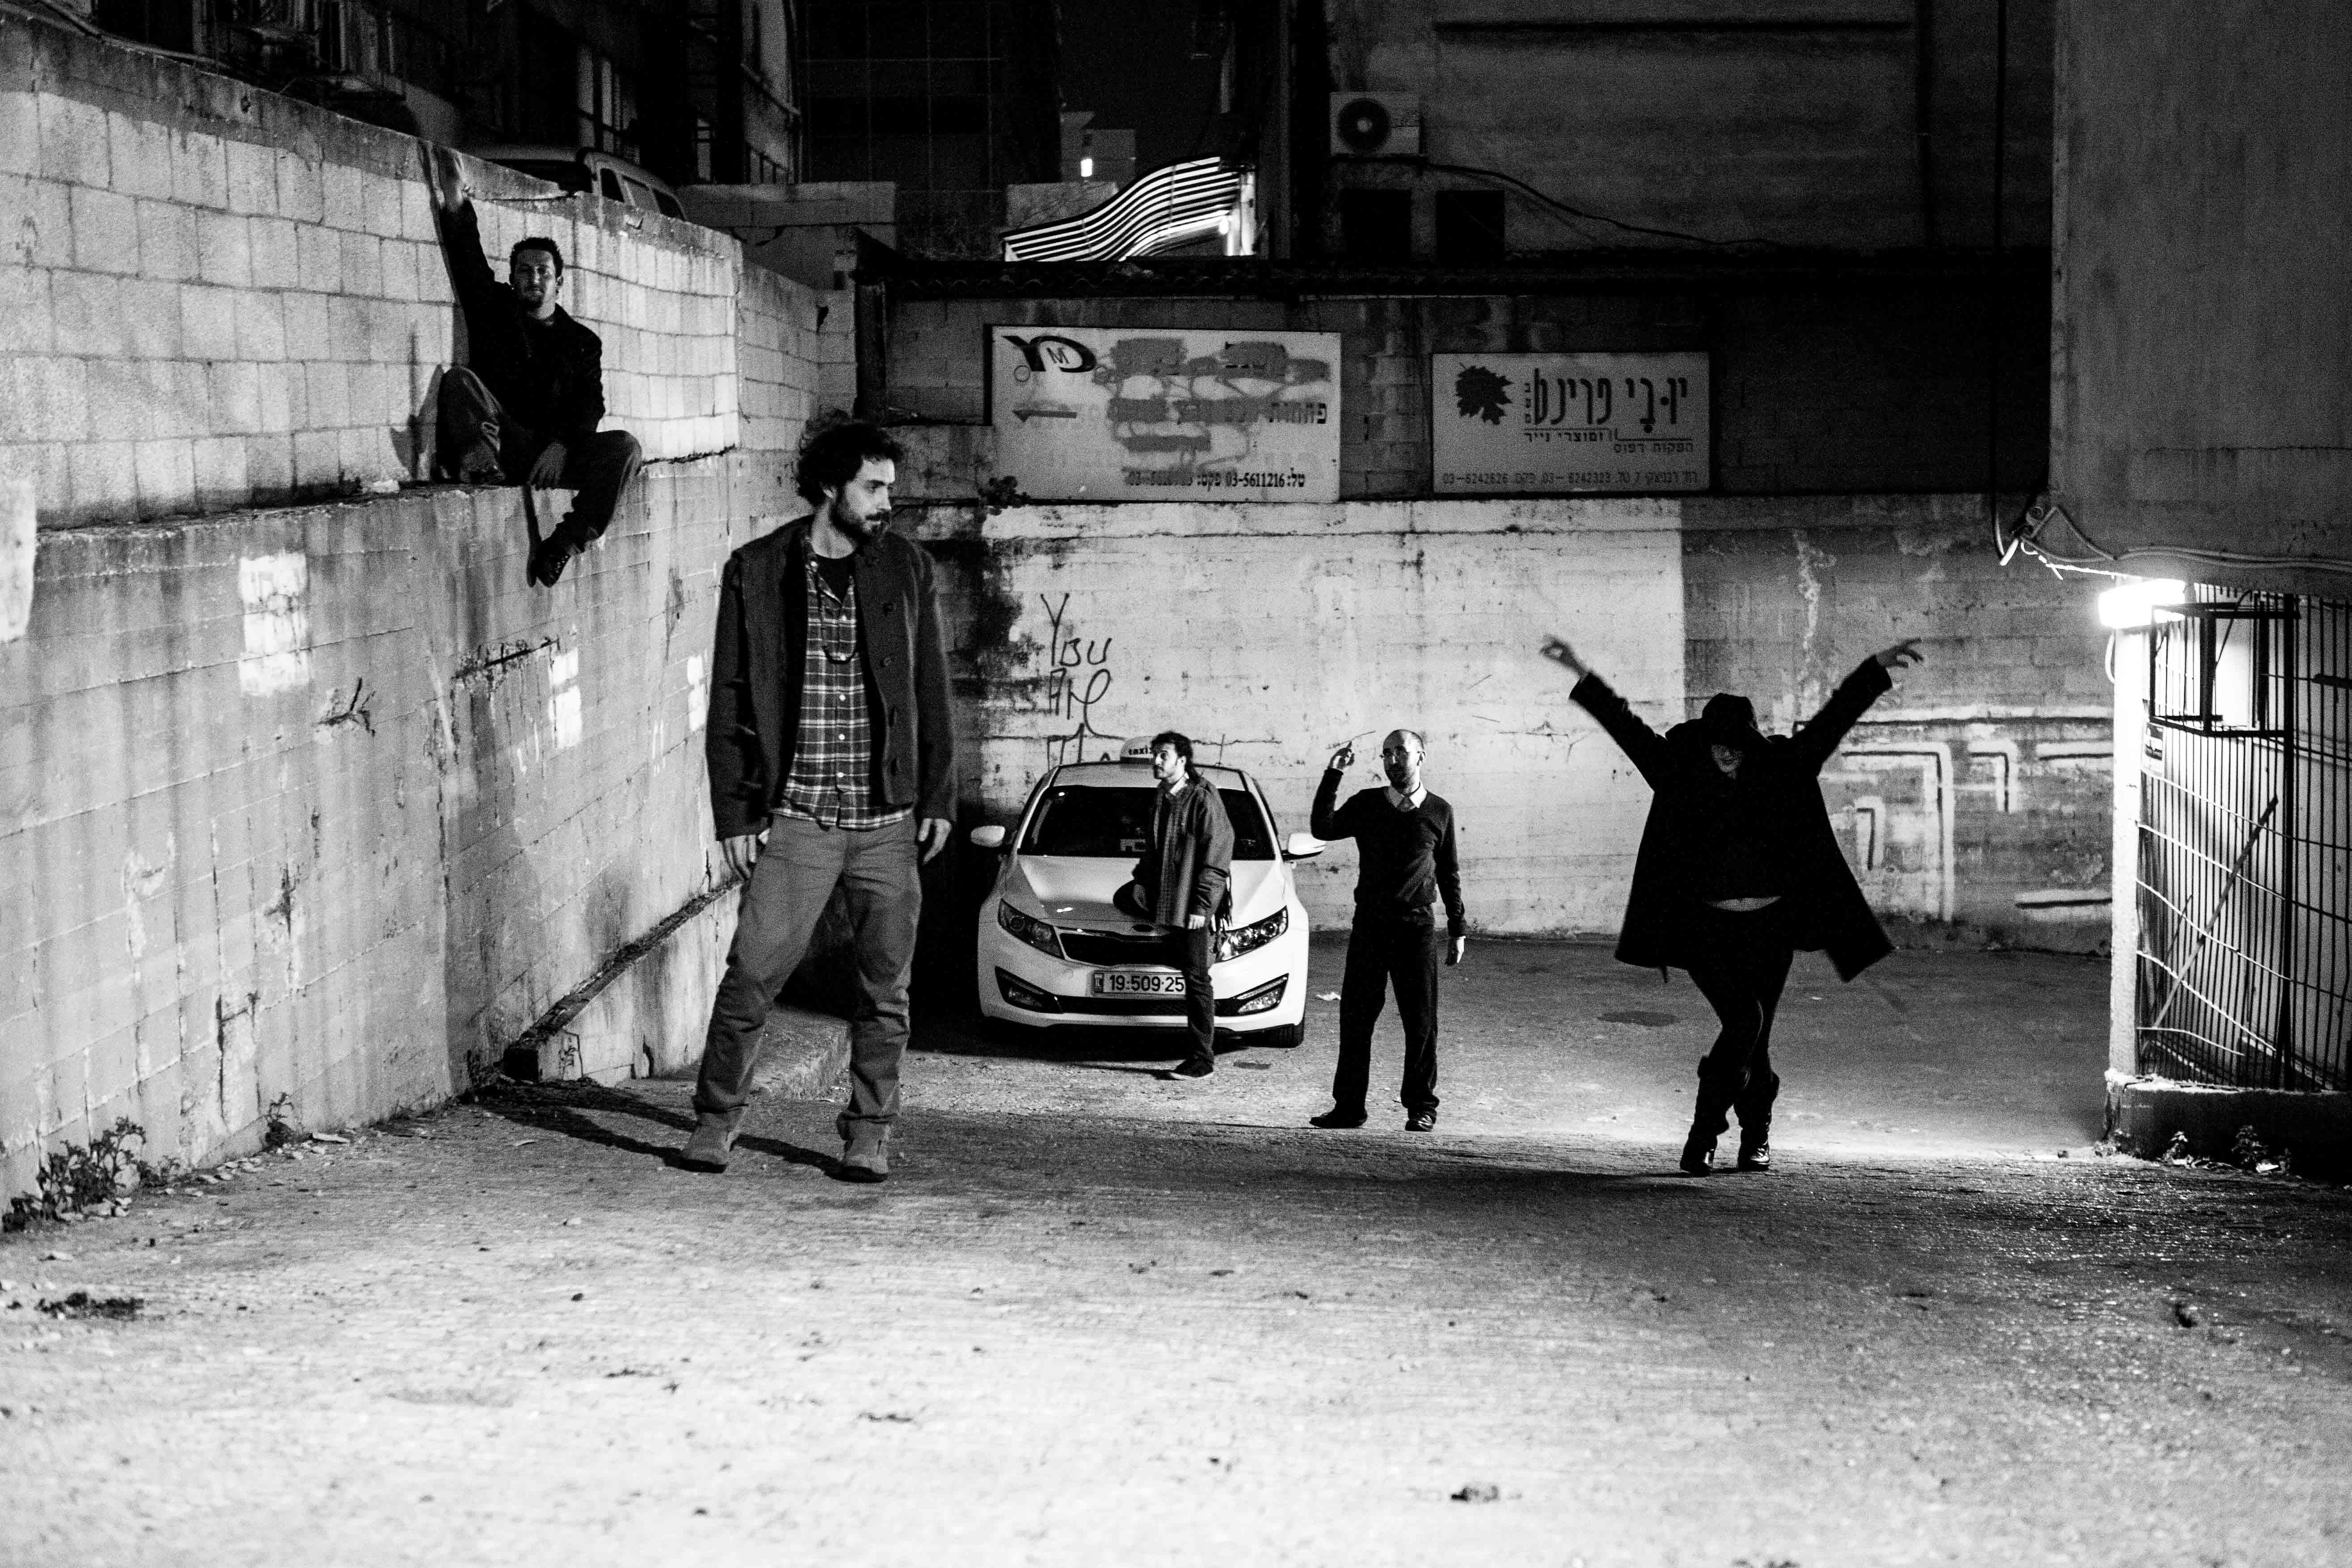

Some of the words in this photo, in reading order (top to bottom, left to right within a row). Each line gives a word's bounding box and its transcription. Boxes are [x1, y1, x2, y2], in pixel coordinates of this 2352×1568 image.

[1534, 367, 1612, 425] פרינט
[1523, 432, 1551, 443] נייר
[1614, 443, 1644, 453] דפוס
[1652, 443, 1693, 453] הפקות
[1225, 472, 1285, 487] 03-5611216
[1287, 467, 1305, 487] טל:
